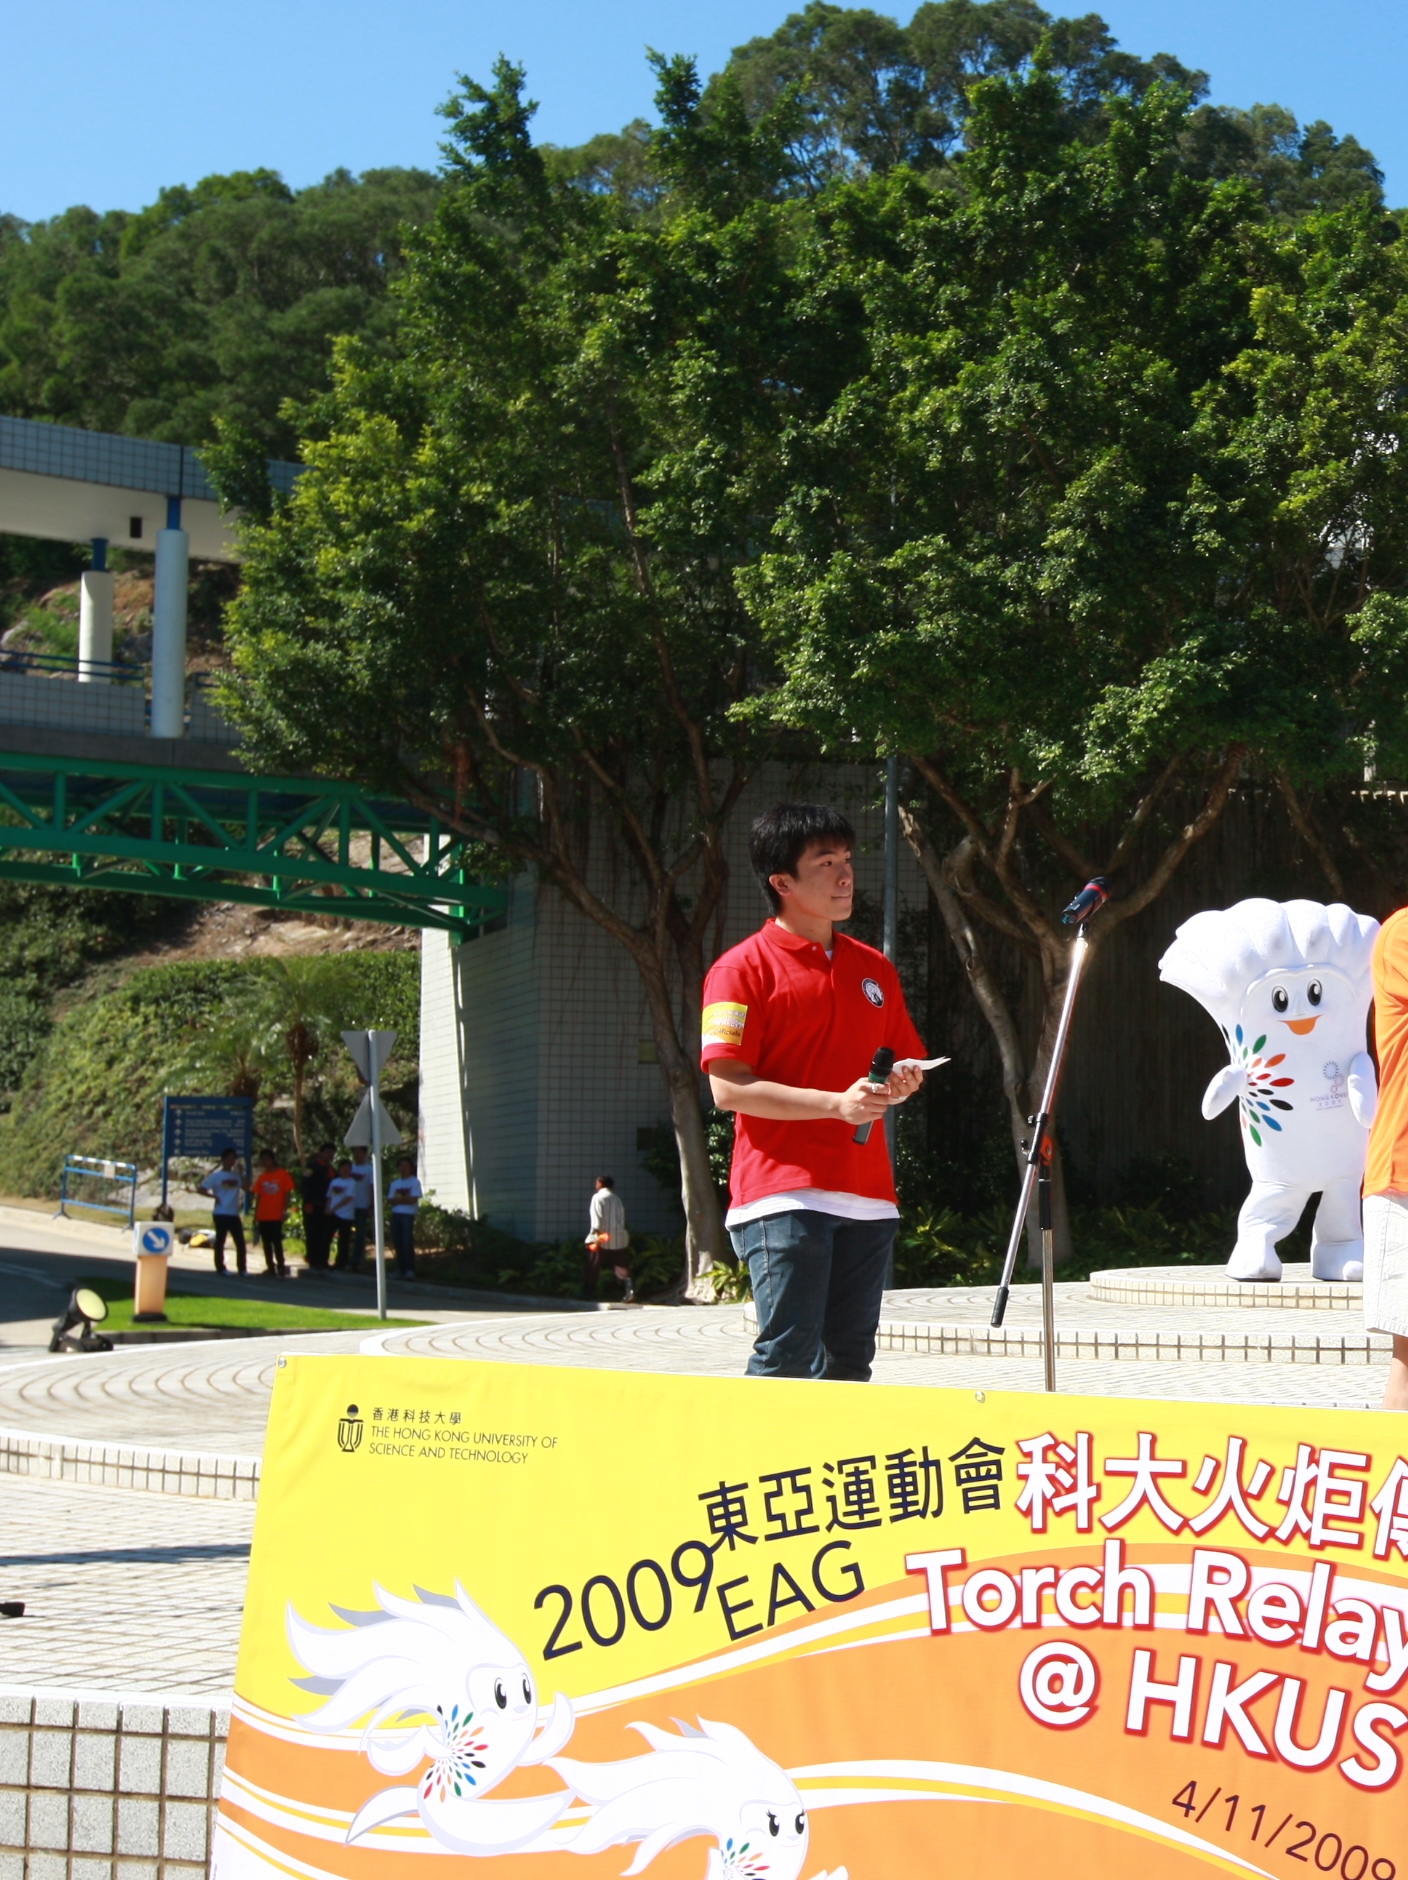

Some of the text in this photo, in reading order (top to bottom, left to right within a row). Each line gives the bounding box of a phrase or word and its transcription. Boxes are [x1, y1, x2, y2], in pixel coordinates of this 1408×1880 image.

[369, 1443, 529, 1464] SCIENCE AND TECHNOLOGY
[371, 1426, 558, 1449] THE HONG KONG UNIVERSITY OF
[372, 1407, 462, 1425] 香港科技大學
[698, 1437, 1006, 1551] 東亞運動會
[533, 1540, 866, 1661] 2009 EAG
[904, 1537, 1155, 1637] Torch
[1018, 1640, 1100, 1730] @
